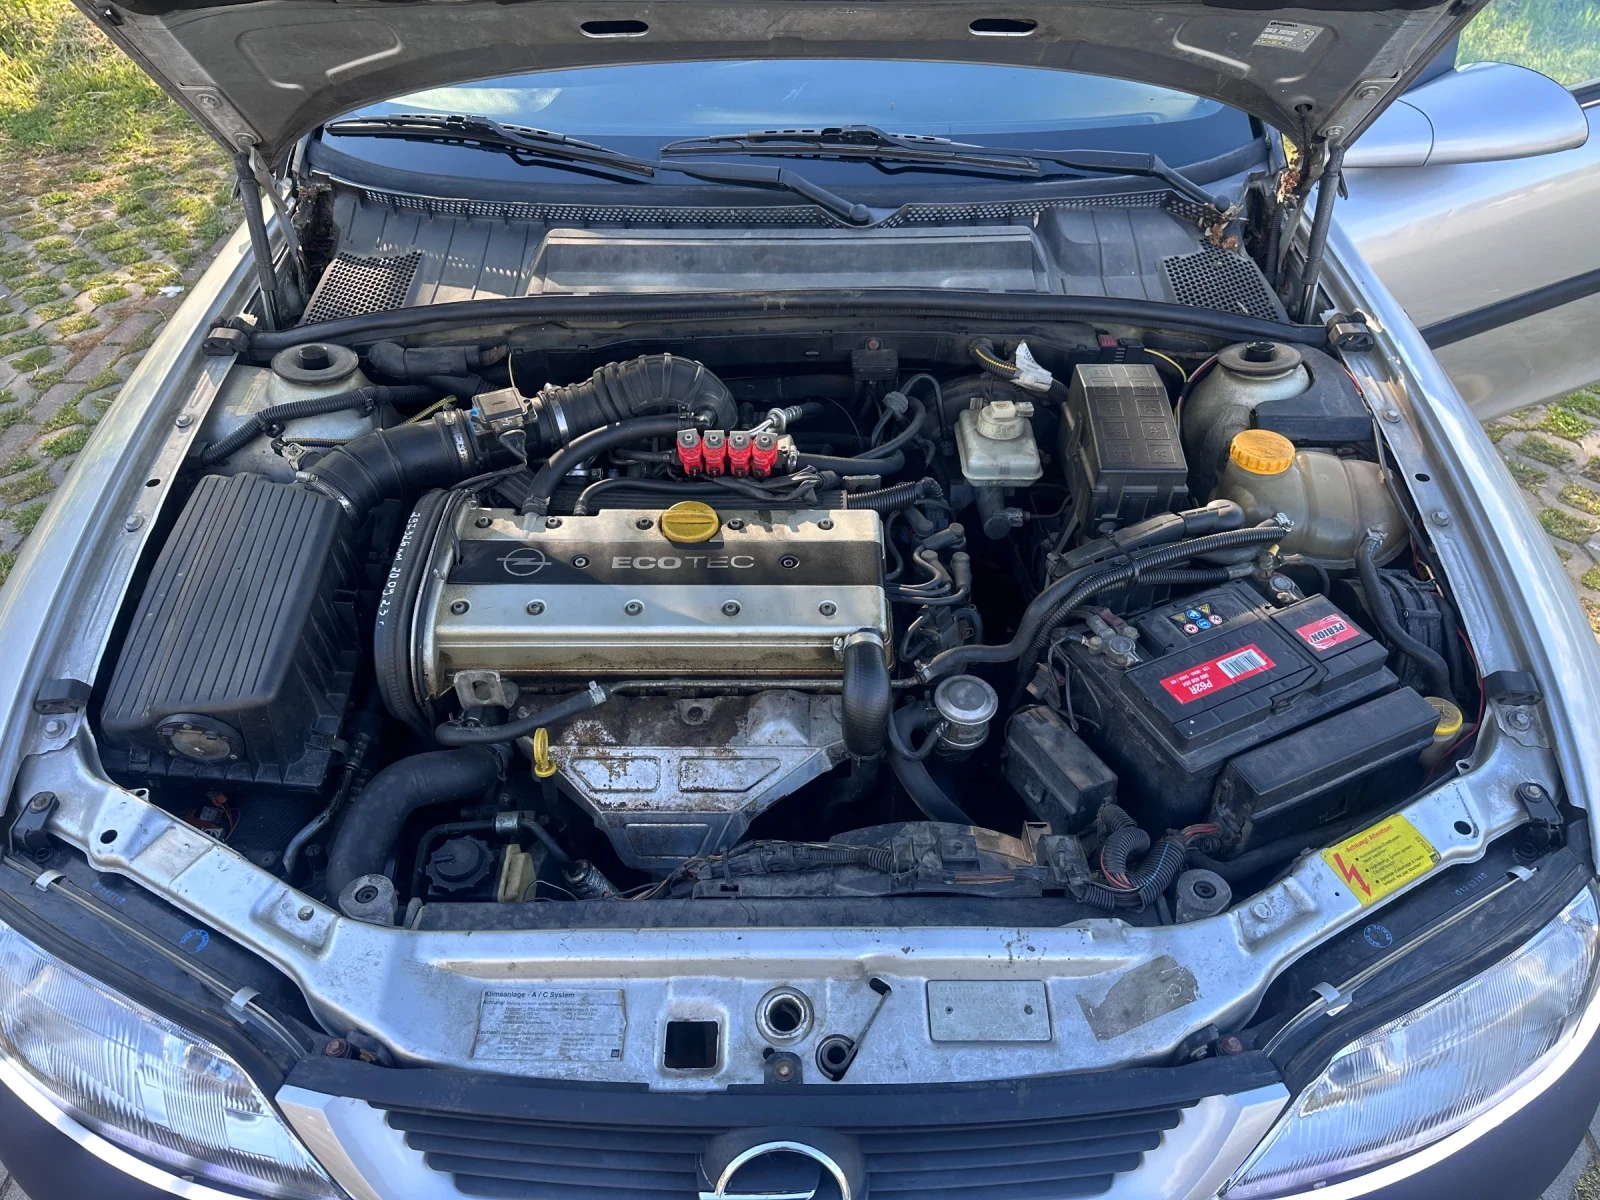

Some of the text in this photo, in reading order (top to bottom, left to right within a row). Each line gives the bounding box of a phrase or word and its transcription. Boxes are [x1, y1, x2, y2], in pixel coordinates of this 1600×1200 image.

[612, 555, 755, 569] ECOTEC
[1310, 622, 1346, 642] PERION
[1188, 679, 1214, 695] P62R
[1346, 824, 1393, 852] Achtung! Attention!
[484, 991, 526, 999] Klimaanlage
[549, 991, 575, 999] System
